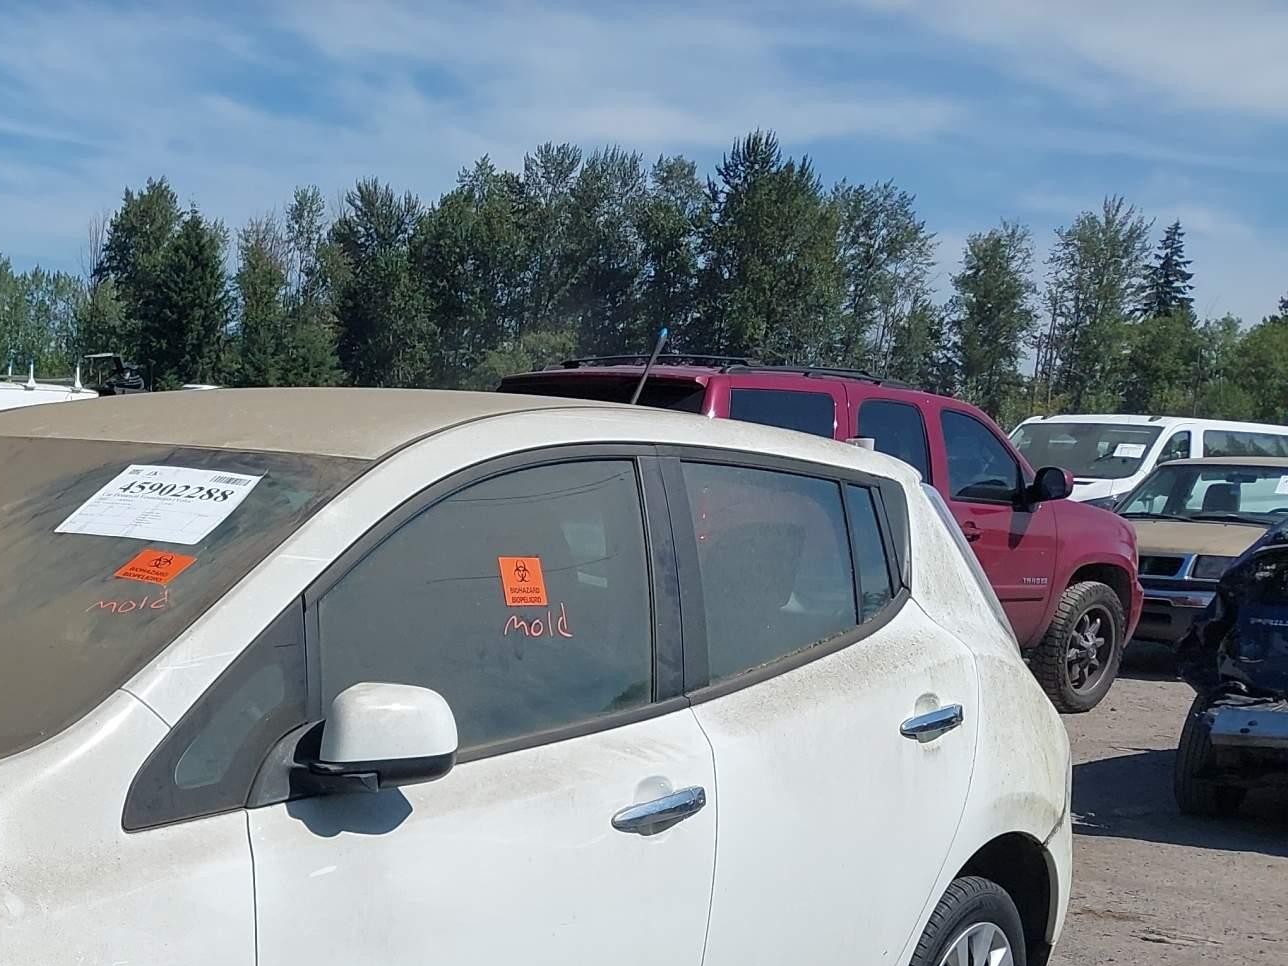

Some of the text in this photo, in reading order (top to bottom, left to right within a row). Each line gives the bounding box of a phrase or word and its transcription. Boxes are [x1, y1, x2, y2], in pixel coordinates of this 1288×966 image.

[118, 480, 236, 503] 45902288
[122, 571, 163, 582] BIOPELIGRO
[129, 566, 169, 578] BIOHAZARD
[509, 586, 541, 594] BIOHAZARD
[86, 588, 169, 613] mold
[511, 596, 542, 604] BIOPELIGRO
[504, 602, 573, 638] mold
